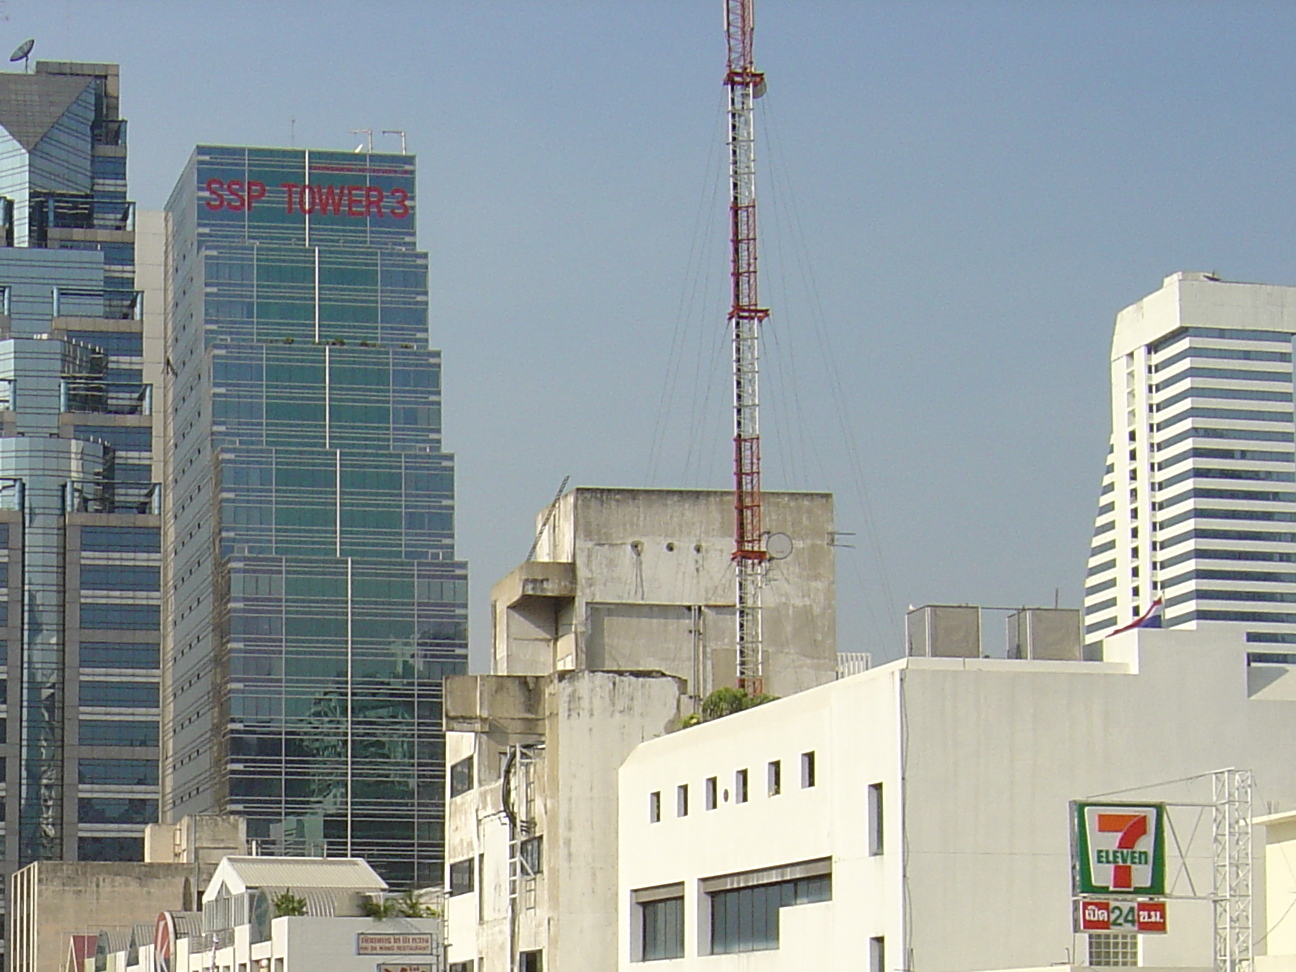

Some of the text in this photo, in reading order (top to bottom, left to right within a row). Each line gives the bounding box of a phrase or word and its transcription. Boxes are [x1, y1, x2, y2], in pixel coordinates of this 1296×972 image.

[205, 178, 410, 219] SSP TOWER 3
[1096, 813, 1148, 889] 7
[1110, 905, 1137, 927] 24
